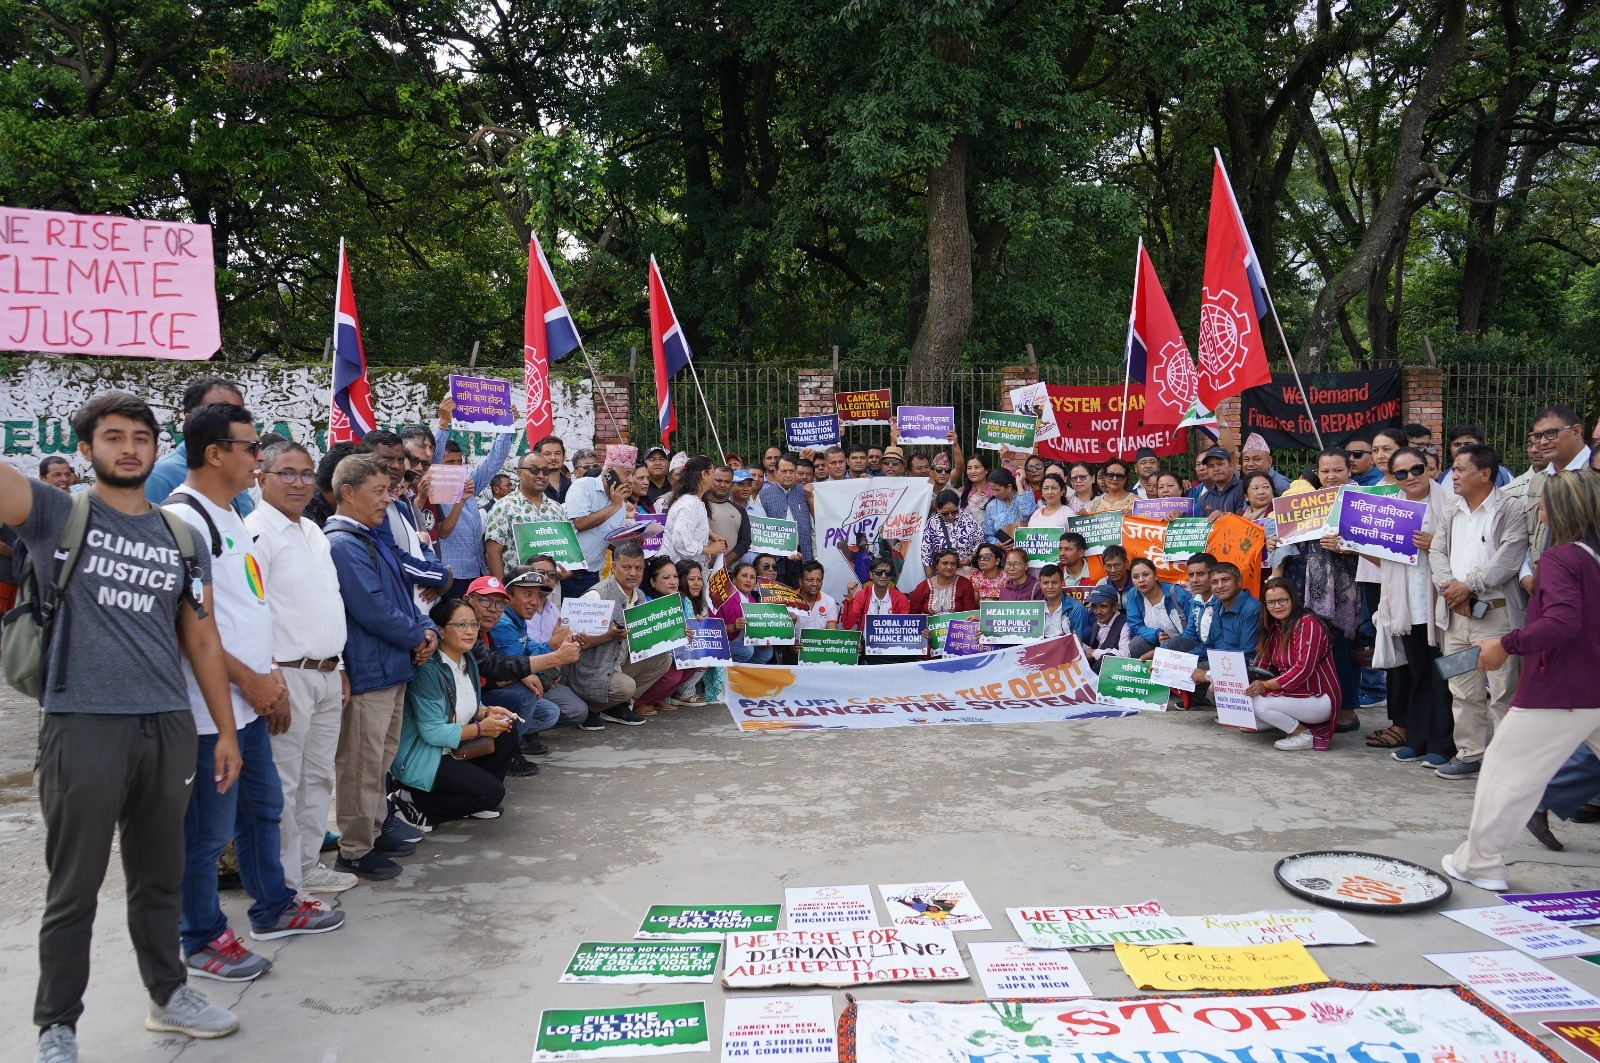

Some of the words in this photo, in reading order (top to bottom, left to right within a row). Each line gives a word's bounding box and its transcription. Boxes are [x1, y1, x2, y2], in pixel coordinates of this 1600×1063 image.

[47, 218, 129, 251] RISE
[144, 226, 197, 258] FOR
[0, 255, 182, 297] CLIMATE
[8, 306, 197, 349] JUSTICE
[457, 392, 472, 402] लागि
[847, 394, 879, 402] CANCEL
[1282, 386, 1306, 404] We
[1310, 382, 1369, 404] Demand
[457, 404, 480, 414] अनुदान
[838, 400, 890, 411] ILLEGITIMATE
[851, 410, 879, 418] DEBTS!
[902, 414, 932, 422] सामाजिक
[1248, 408, 1295, 432] Finance
[1321, 398, 1402, 434] REPARATIONS
[791, 420, 818, 429] GLOBAL
[793, 426, 832, 435] TRANSITION
[981, 418, 1006, 427] CLIMATE
[1008, 421, 1034, 430] FINANCE
[1091, 419, 1118, 432] NOT
[790, 433, 817, 442] FINANCE
[819, 432, 836, 440] NOW!
[1002, 433, 1025, 442] PROFIT!
[1047, 436, 1099, 454] CLIMATE
[1106, 430, 1170, 452] CHANGE!
[860, 500, 888, 508] ACTION
[1350, 500, 1377, 513] महिला
[1378, 504, 1414, 520] अधिकार
[886, 512, 922, 528] CANCEL
[1360, 514, 1373, 527] को
[1374, 516, 1396, 530] लागि
[824, 524, 851, 548] PAY
[854, 516, 879, 538] UP!
[884, 530, 902, 538] THE
[1070, 525, 1091, 534] CLIMATE
[1092, 522, 1114, 531] FINANCE
[1082, 529, 1112, 538] OBLIGATION
[754, 535, 785, 546] FINANCE!
[1380, 530, 1394, 543] कर
[1395, 533, 1404, 544] !!!
[86, 529, 180, 567] CLIMATE
[84, 556, 178, 591] JUSTICE
[98, 586, 157, 613] NOW
[627, 618, 648, 628] जलवायु
[648, 610, 668, 622] परिवर्तन
[653, 619, 676, 631] परिवर्तन
[1122, 664, 1140, 674] गरिबी
[738, 698, 786, 708] PAY
[794, 698, 840, 707] UP!
[848, 692, 950, 705] CANCEL
[955, 682, 1010, 702] THE
[1008, 660, 1087, 700] DEBT!
[1136, 688, 1148, 696] गर।
[744, 704, 894, 718] CHANGE
[894, 701, 966, 713] THE
[966, 683, 1096, 710] SYSTEM!
[1020, 908, 1061, 922] WE
[1060, 906, 1128, 922] RISE
[1026, 921, 1102, 934] REAL
[1260, 924, 1294, 934] NOT
[734, 933, 770, 949] WE
[773, 931, 842, 946] RISE
[853, 929, 902, 946] FOR
[1058, 926, 1188, 945] SOLUTION
[702, 952, 716, 960] IS
[746, 942, 946, 964] DISMANTLING
[728, 958, 876, 977] AUSTERITY
[854, 966, 960, 982] MODELS
[1204, 964, 1235, 972] OVER
[1164, 971, 1250, 984] CORPORATE
[1507, 994, 1572, 1002] CONVENTION
[583, 1014, 620, 1025] FILL
[624, 1012, 659, 1022] THE
[1056, 1002, 1306, 1036] STOP
[546, 1024, 595, 1036] LOSS
[600, 1023, 615, 1033] &
[620, 1018, 700, 1032] DAMAGE
[570, 1031, 622, 1042] FUND
[626, 1028, 674, 1039] NOW!
[766, 1038, 812, 1046] STRONG
[756, 1046, 832, 1056] CONVENTION
